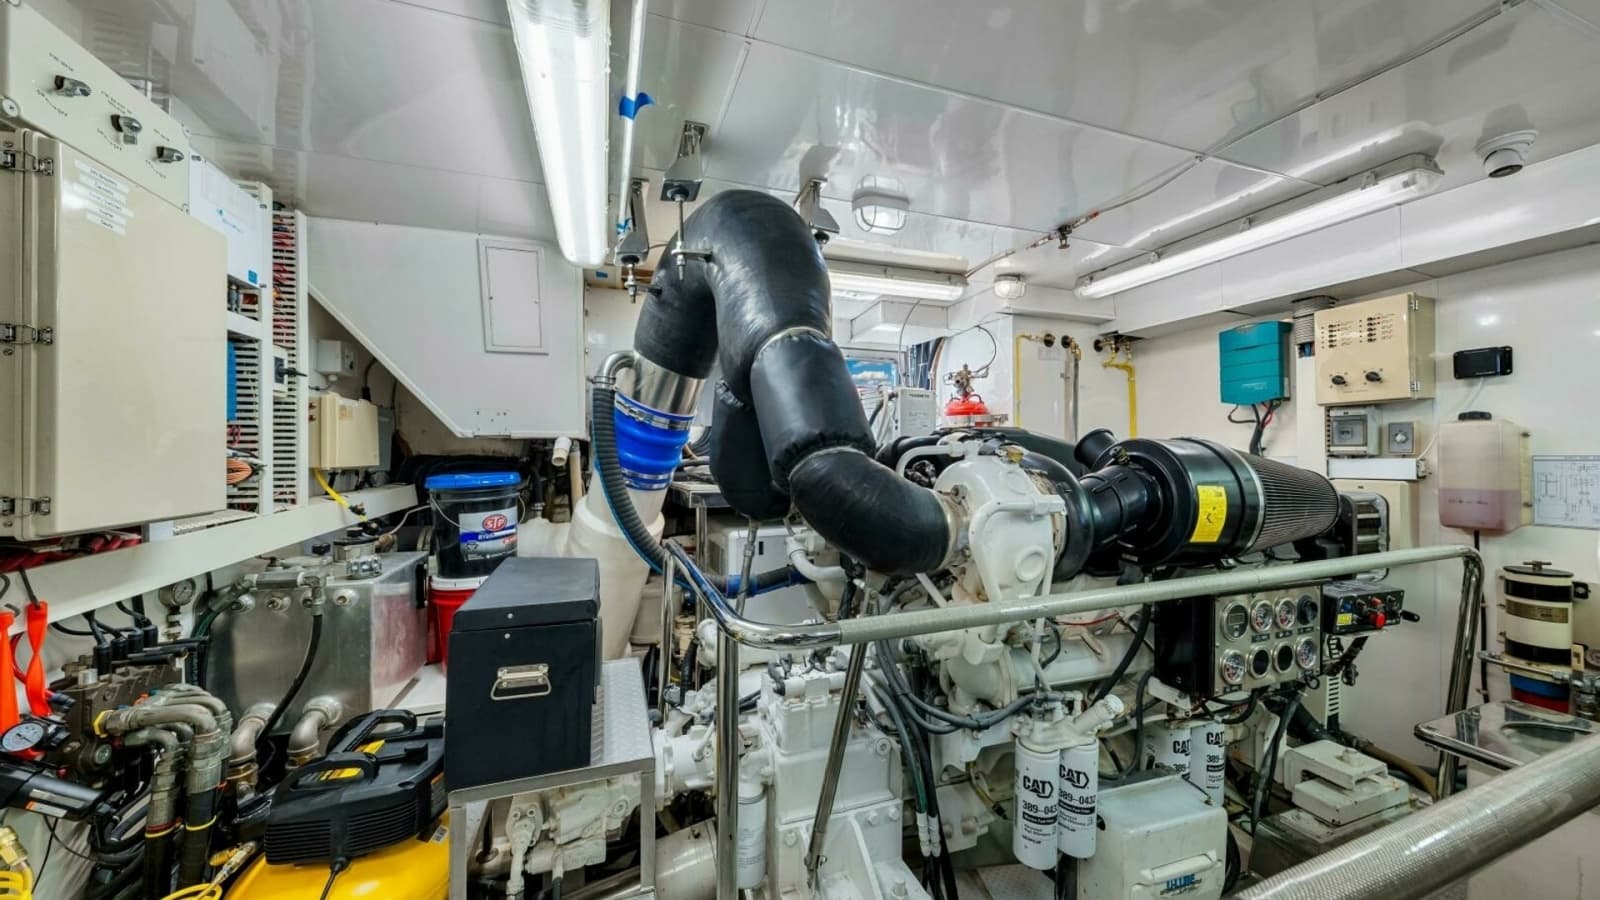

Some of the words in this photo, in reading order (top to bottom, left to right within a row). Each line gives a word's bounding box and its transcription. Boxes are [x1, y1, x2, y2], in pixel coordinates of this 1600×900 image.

[484, 516, 507, 530] STP
[1023, 775, 1052, 797] CAT
[1059, 764, 1087, 787] CAT
